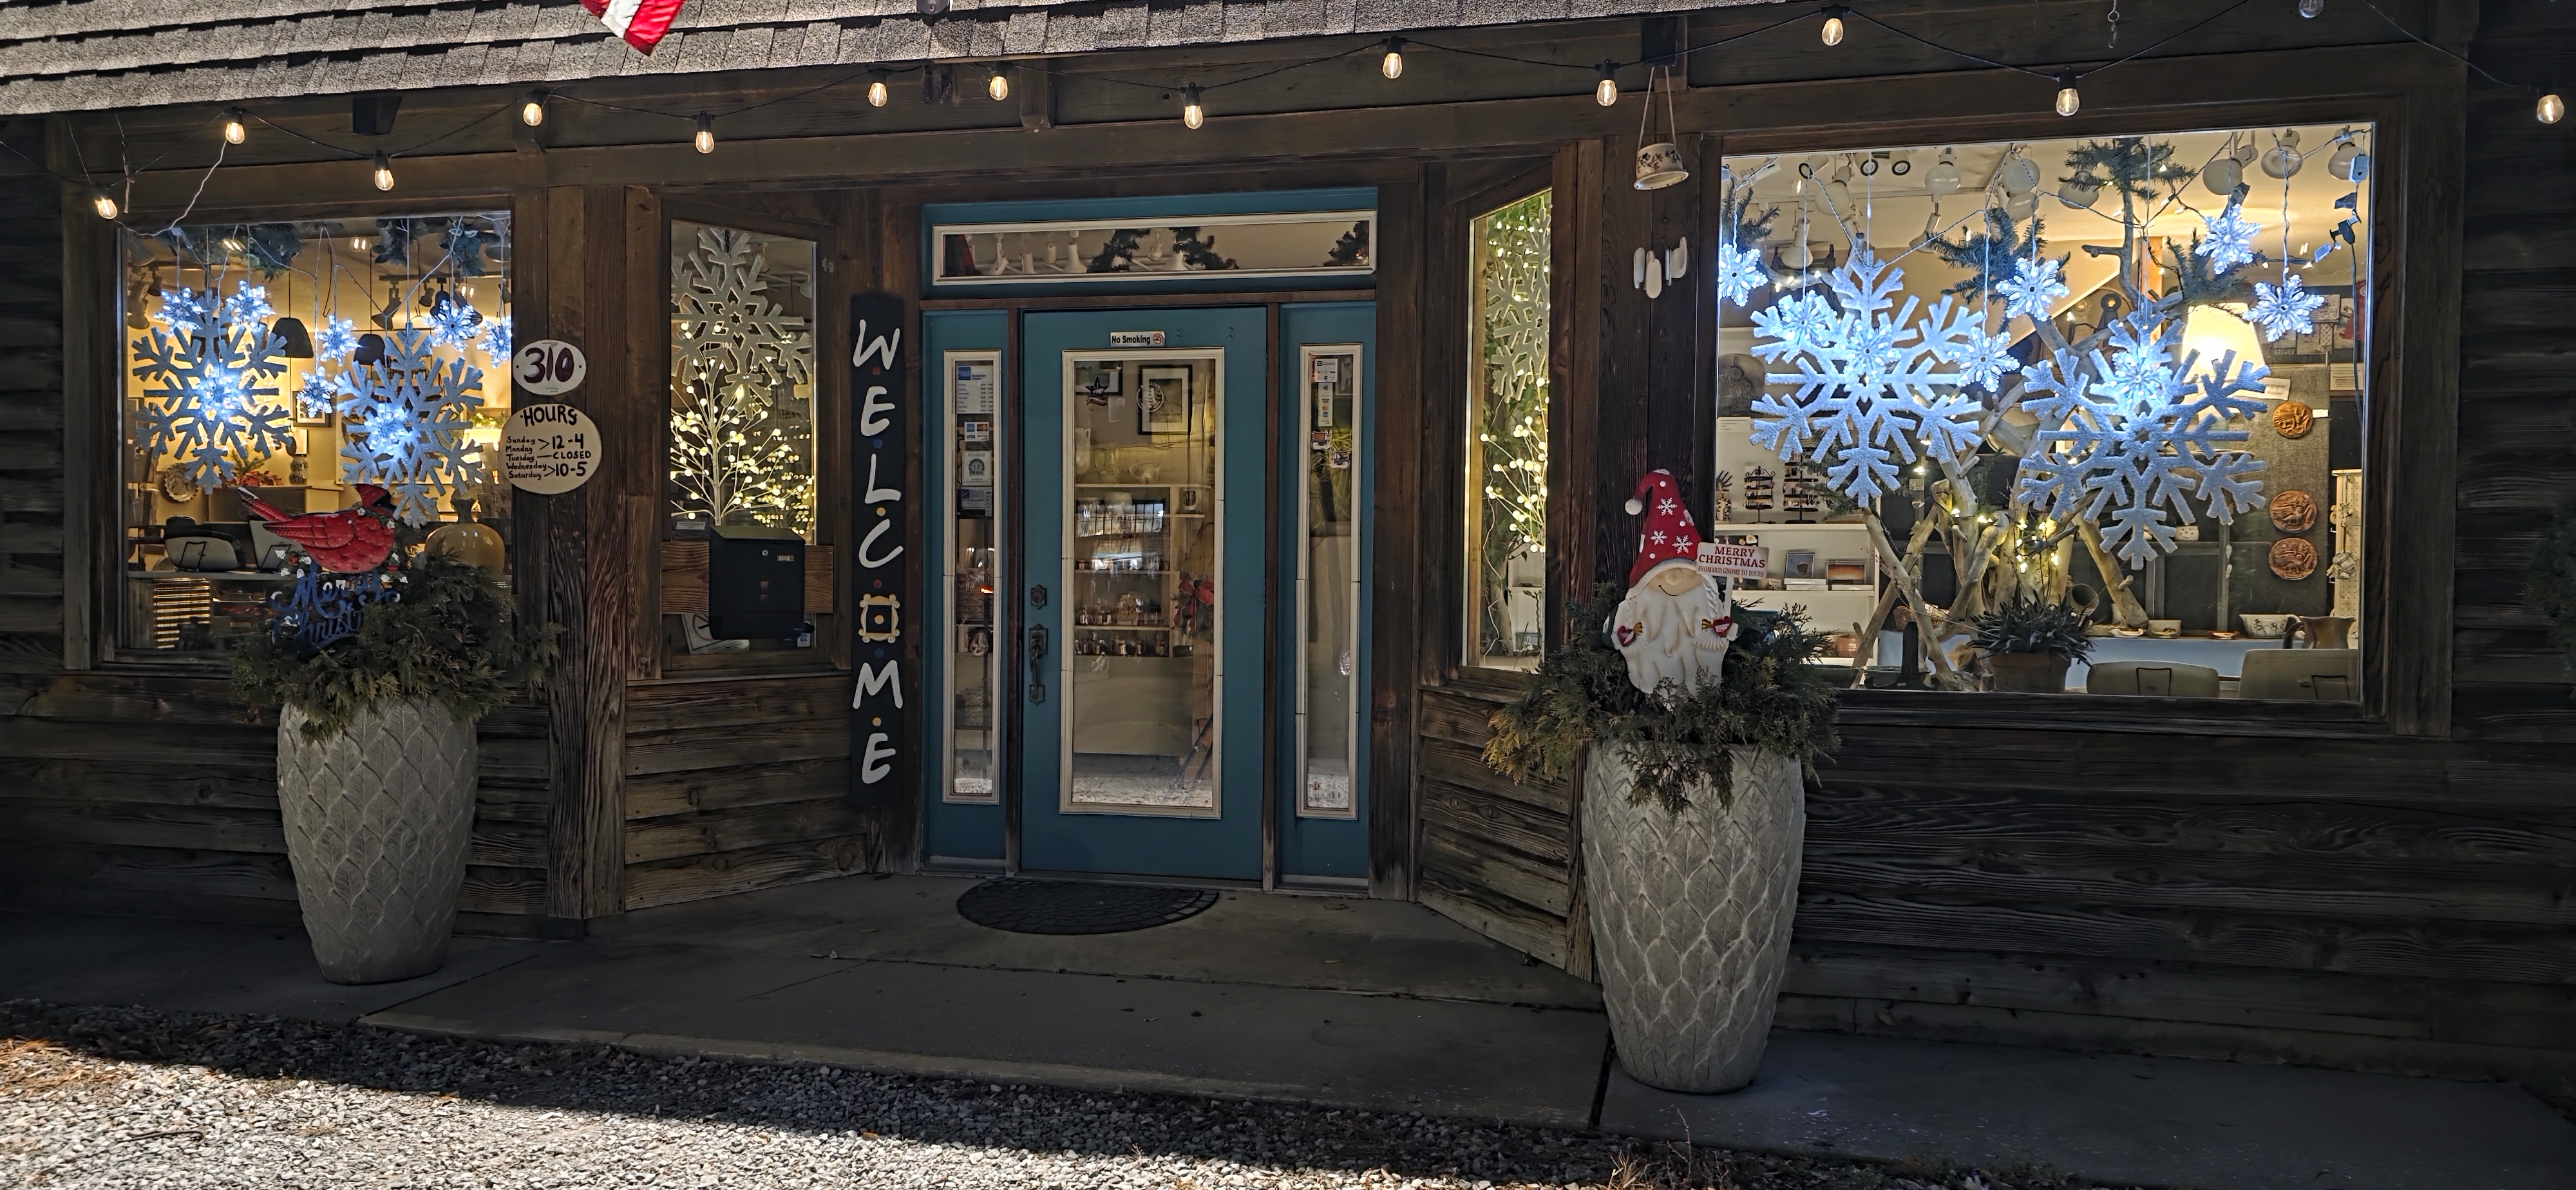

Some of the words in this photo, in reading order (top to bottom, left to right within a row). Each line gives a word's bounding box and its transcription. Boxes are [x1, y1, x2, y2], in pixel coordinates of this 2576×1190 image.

[1112, 335, 1121, 344] No
[1122, 335, 1151, 345] Smoking
[524, 347, 574, 384] 310
[522, 404, 578, 427] HOURS
[506, 436, 536, 445] Sunday
[506, 445, 533, 455] Monday
[506, 453, 535, 463] Tuesday
[553, 451, 591, 459] CLOSED
[506, 461, 547, 471] Wednesday
[508, 470, 542, 480] Saturday
[853, 319, 904, 784] WELCOME
[1714, 545, 1755, 558] MERRY
[1698, 554, 1766, 568] CHRISTMAS
[1723, 567, 1741, 576] GNOME
